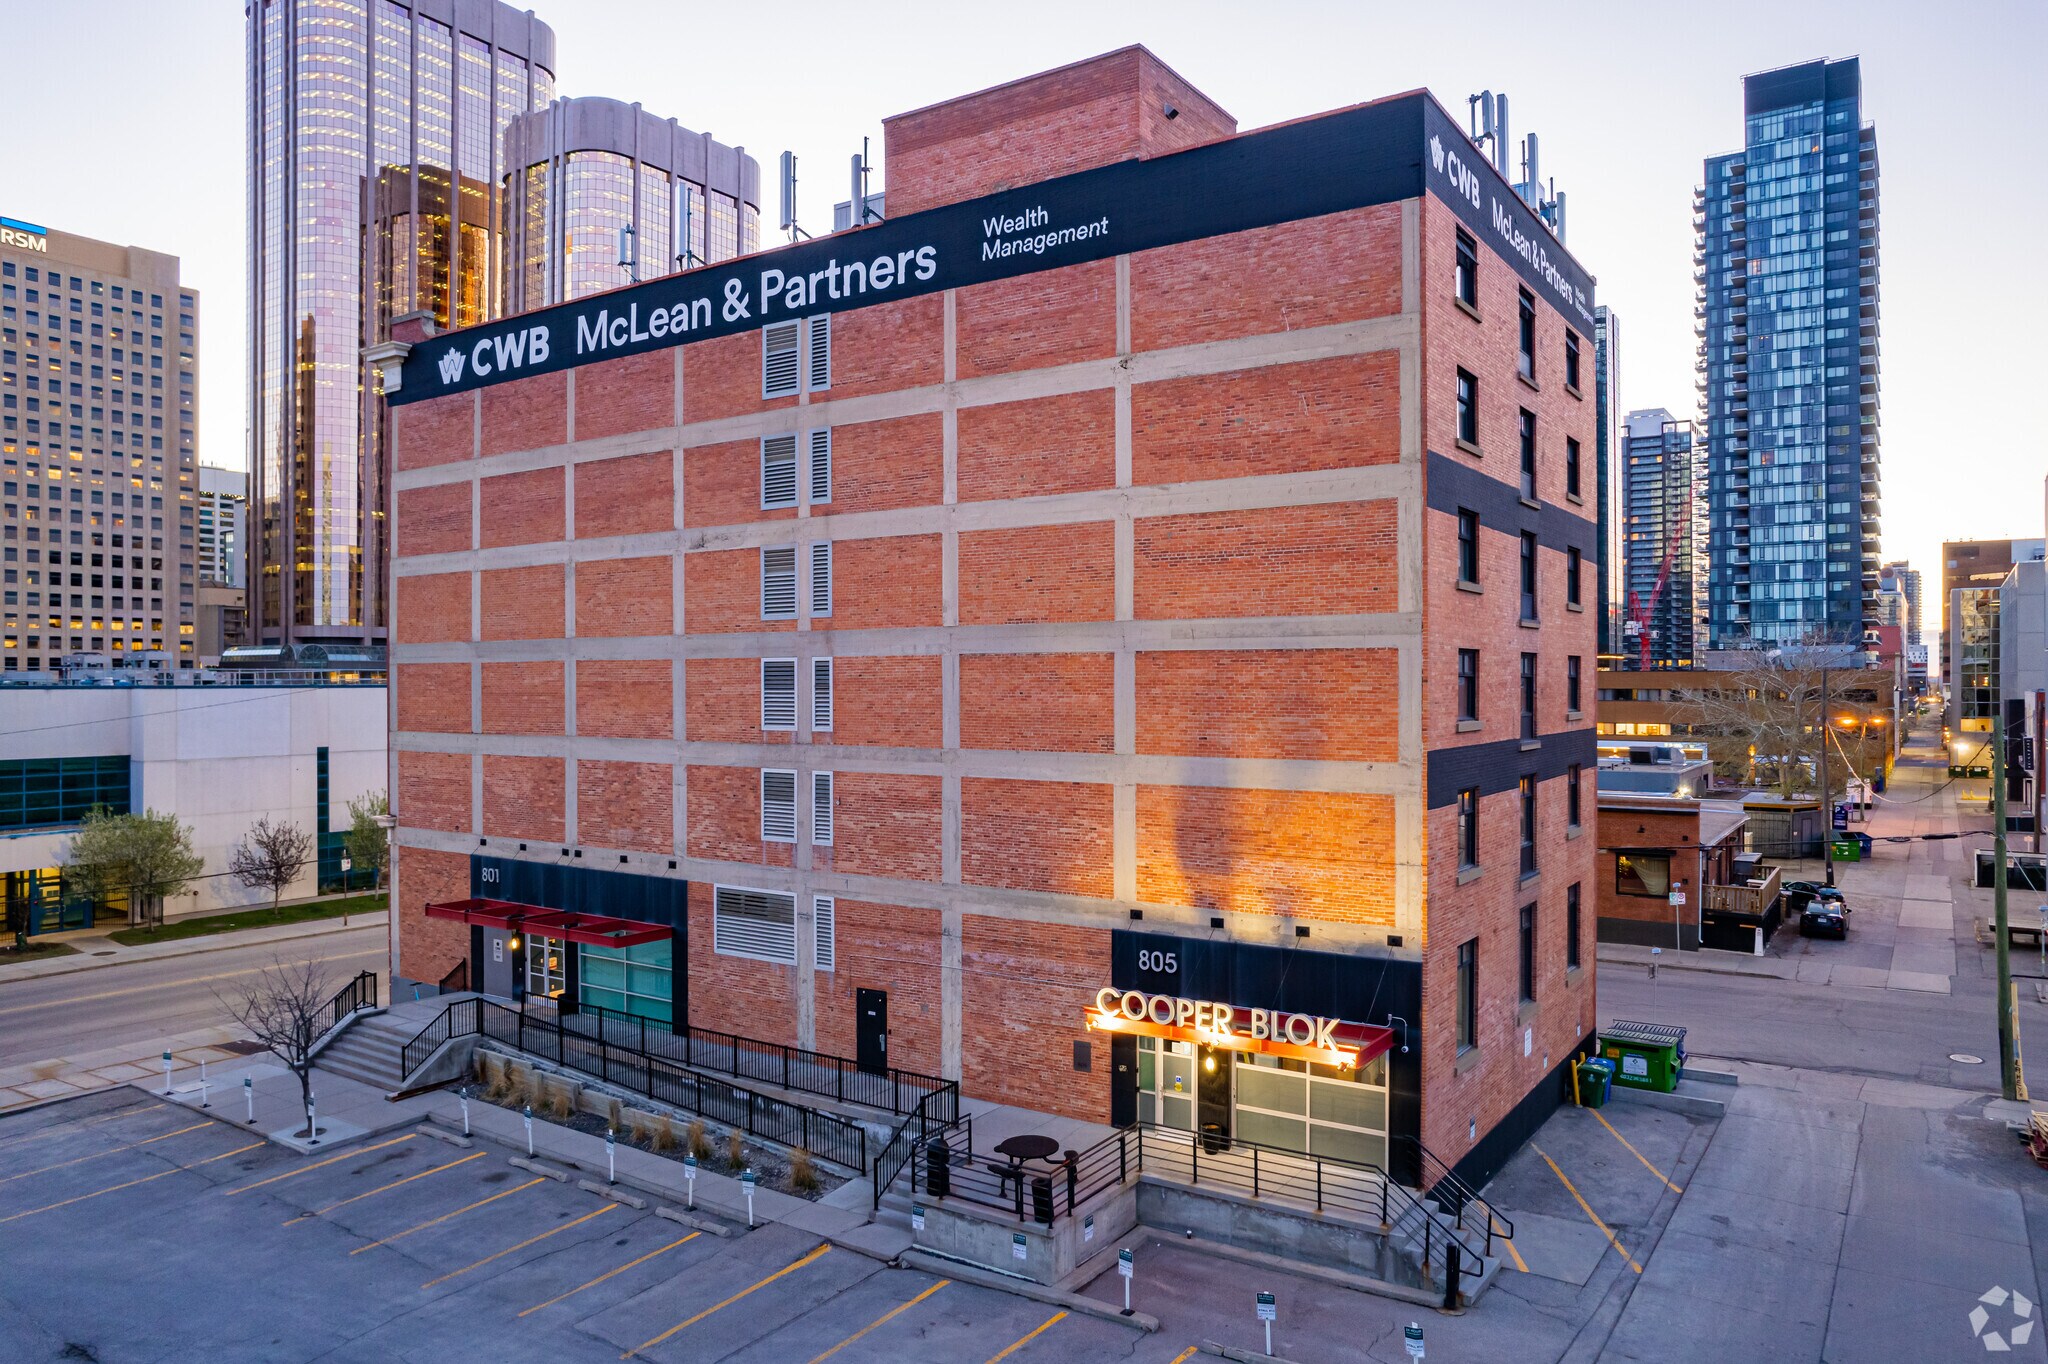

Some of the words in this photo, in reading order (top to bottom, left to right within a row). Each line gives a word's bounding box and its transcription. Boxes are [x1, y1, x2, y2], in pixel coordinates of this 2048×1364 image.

[1, 228, 47, 253] RSM
[981, 216, 1109, 261] Management
[982, 205, 1049, 238] Wealth
[1448, 150, 1480, 210] CWB
[1492, 196, 1532, 263] McLean
[1532, 240, 1540, 272] &
[1540, 247, 1573, 305] Partners
[471, 325, 550, 377] CWB
[576, 297, 712, 354] McLean
[722, 277, 751, 322] &
[761, 245, 938, 315] Partners
[481, 867, 499, 883] 801
[1138, 949, 1178, 974] 805
[1096, 986, 1235, 1036] COOPER
[1251, 1007, 1341, 1052] BLOK
